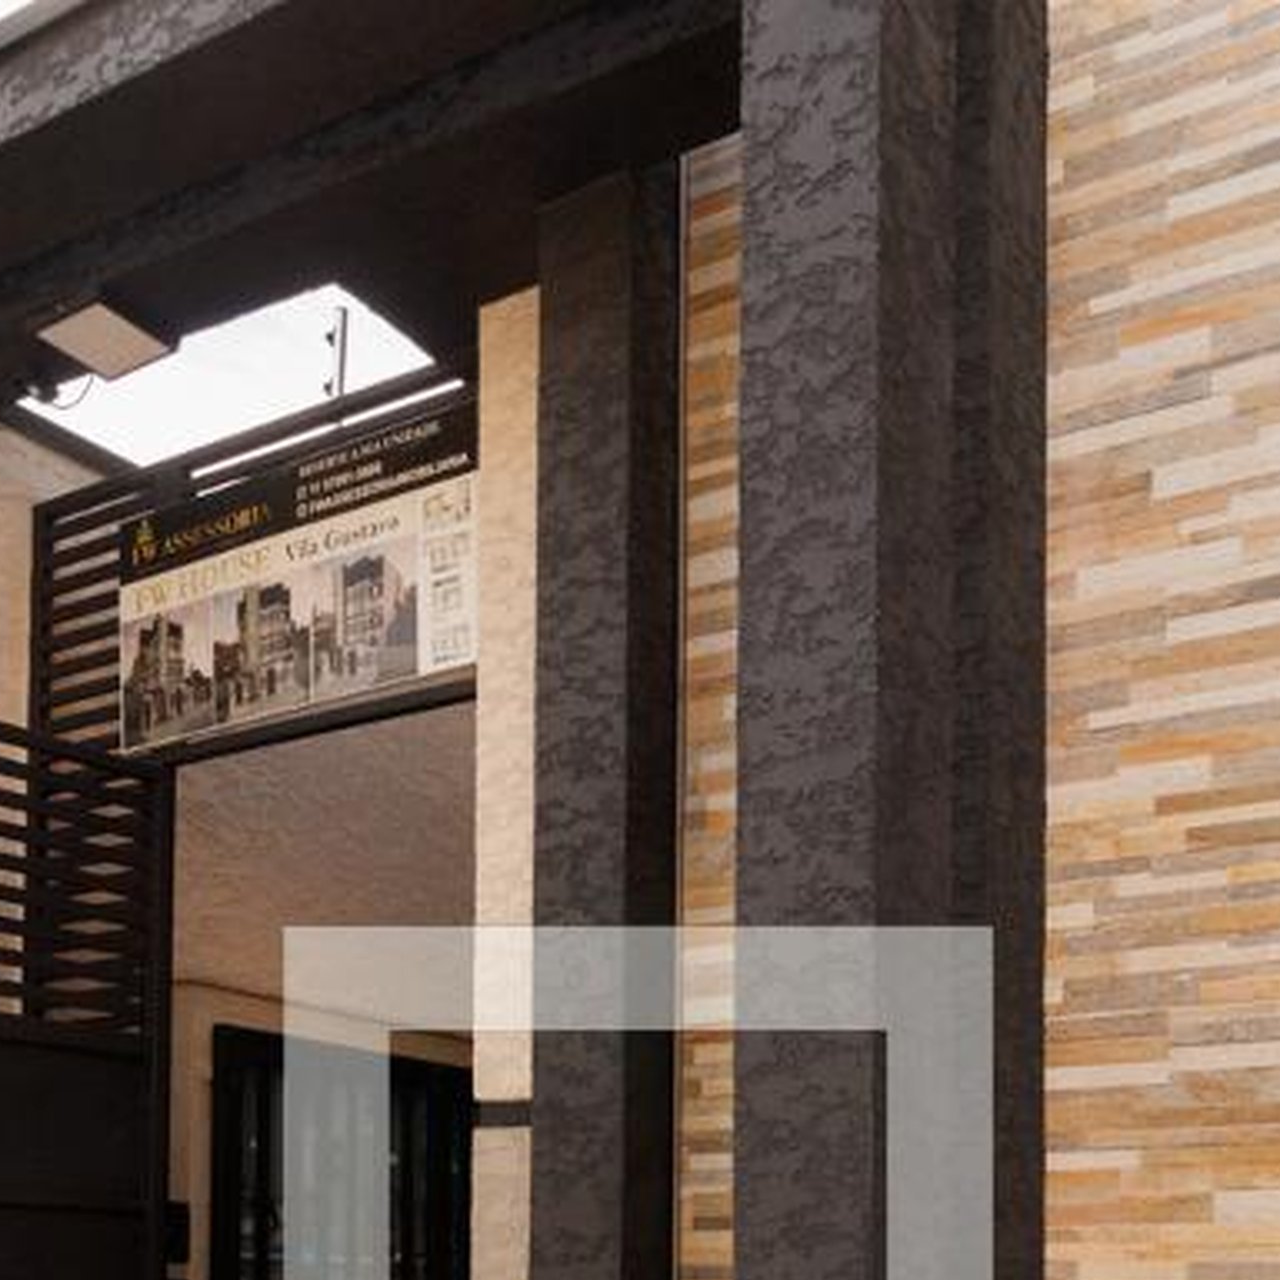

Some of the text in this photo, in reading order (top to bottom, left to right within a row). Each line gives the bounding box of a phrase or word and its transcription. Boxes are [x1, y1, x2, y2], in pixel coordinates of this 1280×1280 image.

[178, 545, 270, 601] HOUSE
[286, 537, 318, 561] Vila
[324, 517, 400, 550] Gustavo
